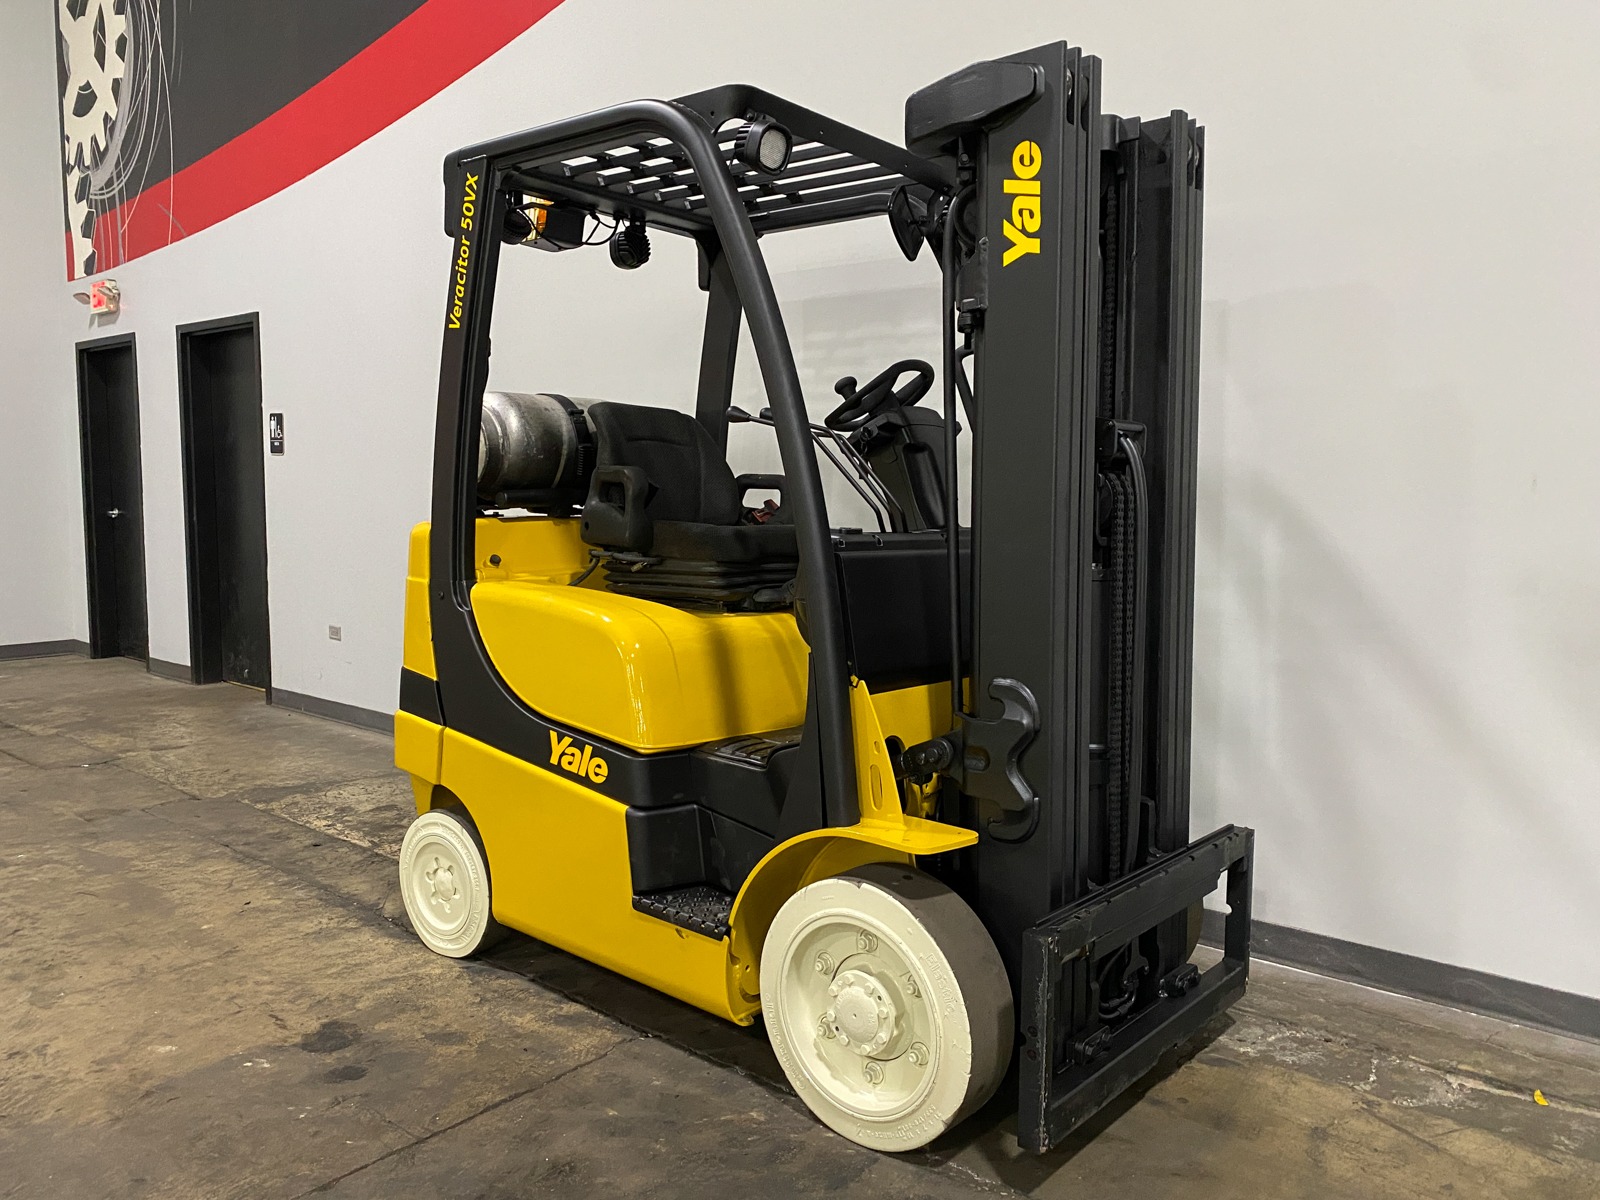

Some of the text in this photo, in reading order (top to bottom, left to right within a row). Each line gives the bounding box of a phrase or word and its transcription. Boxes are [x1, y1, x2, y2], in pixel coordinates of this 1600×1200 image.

[448, 172, 479, 329] Veracitor 50VX
[1002, 140, 1042, 267] Yale
[549, 729, 608, 784] Yale
